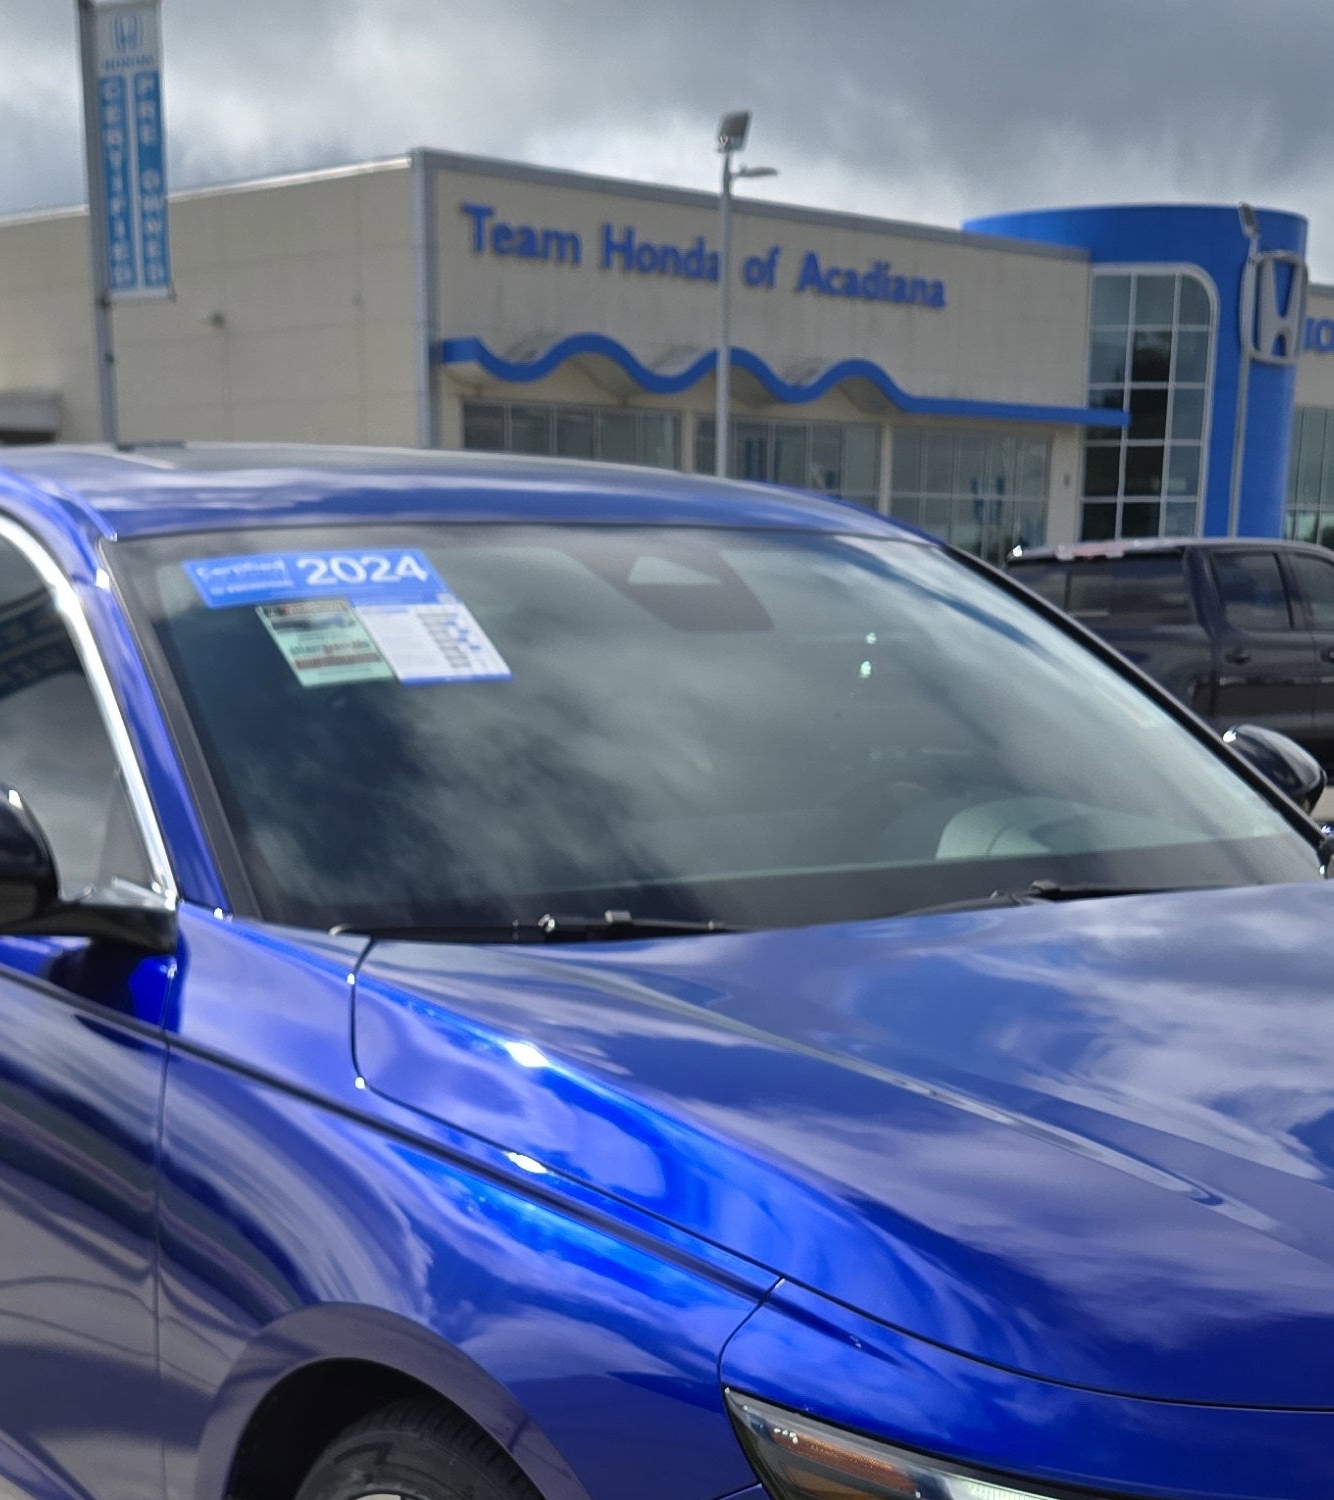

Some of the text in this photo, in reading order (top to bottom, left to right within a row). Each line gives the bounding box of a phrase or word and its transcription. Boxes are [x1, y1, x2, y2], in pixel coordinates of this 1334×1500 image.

[461, 203, 580, 265] Team
[743, 245, 782, 288] of
[797, 251, 945, 307] Acadiana
[296, 556, 428, 585] 2024
